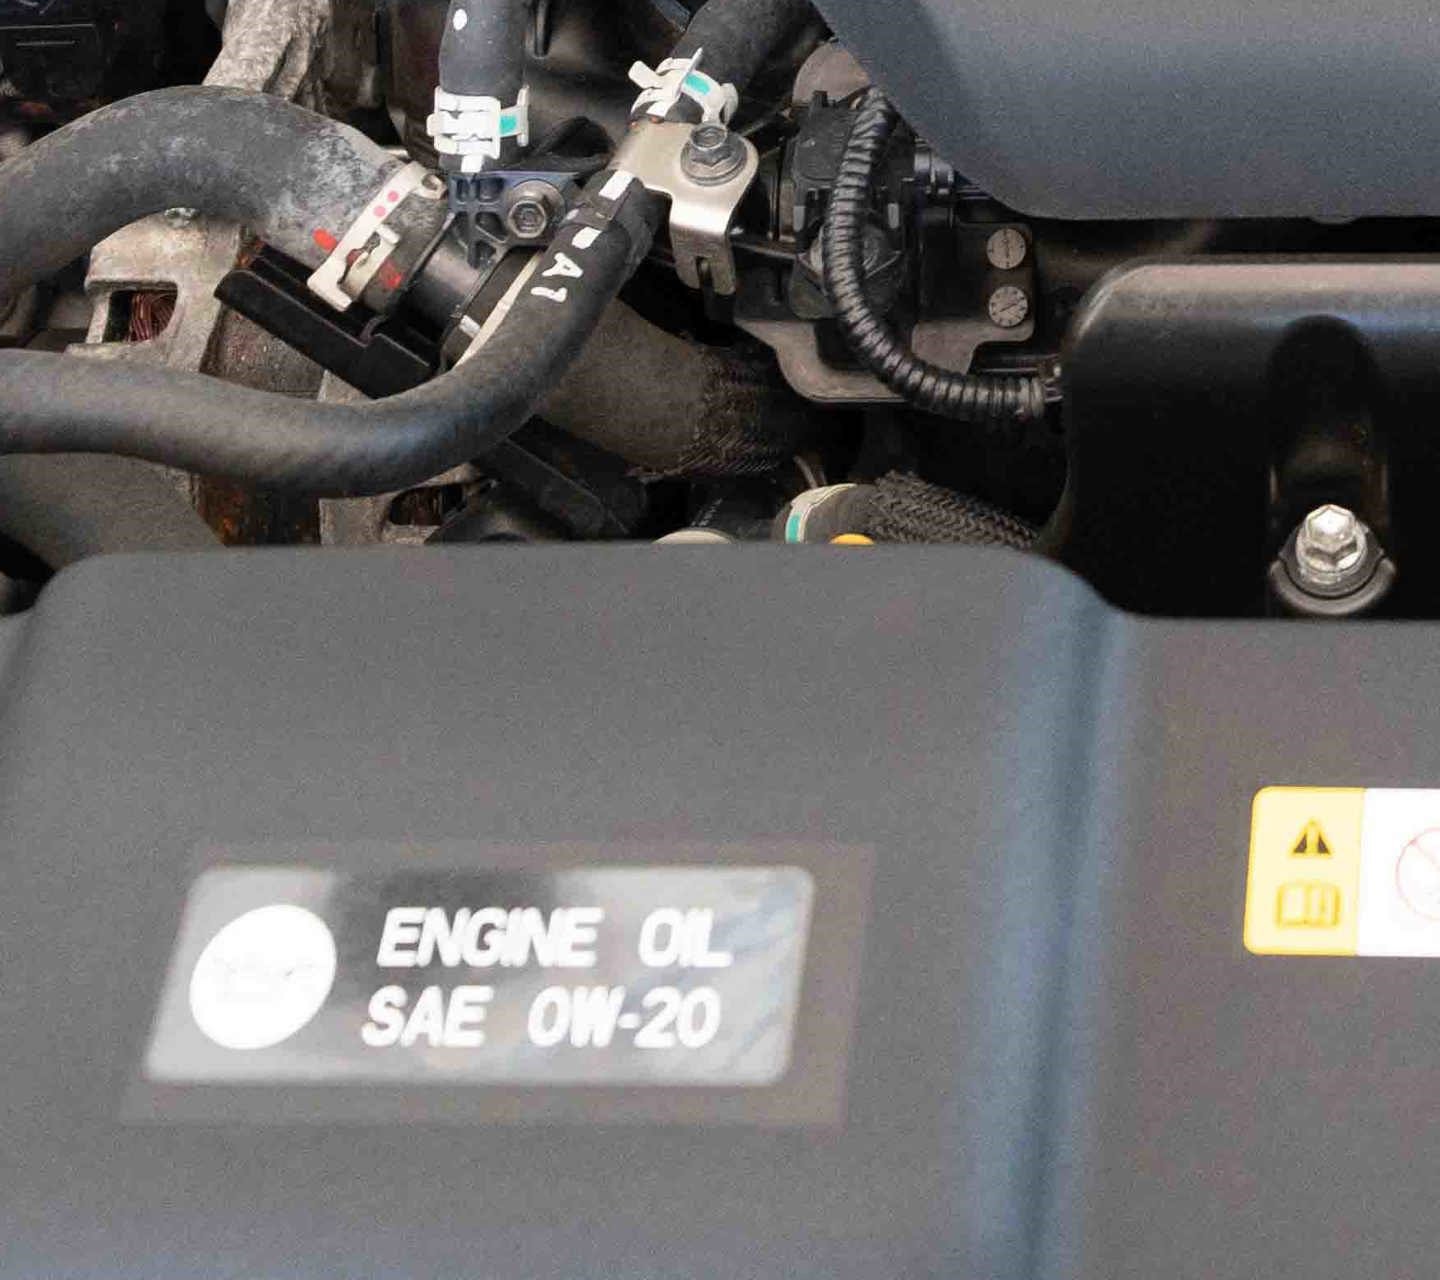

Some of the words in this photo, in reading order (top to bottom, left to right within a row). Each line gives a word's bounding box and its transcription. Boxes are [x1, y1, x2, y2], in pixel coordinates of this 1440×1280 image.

[530, 251, 584, 304] A1
[376, 905, 605, 969] ENGINE
[637, 905, 734, 969] OIL
[359, 985, 495, 1050] SAE
[526, 985, 724, 1050] 0W-20
